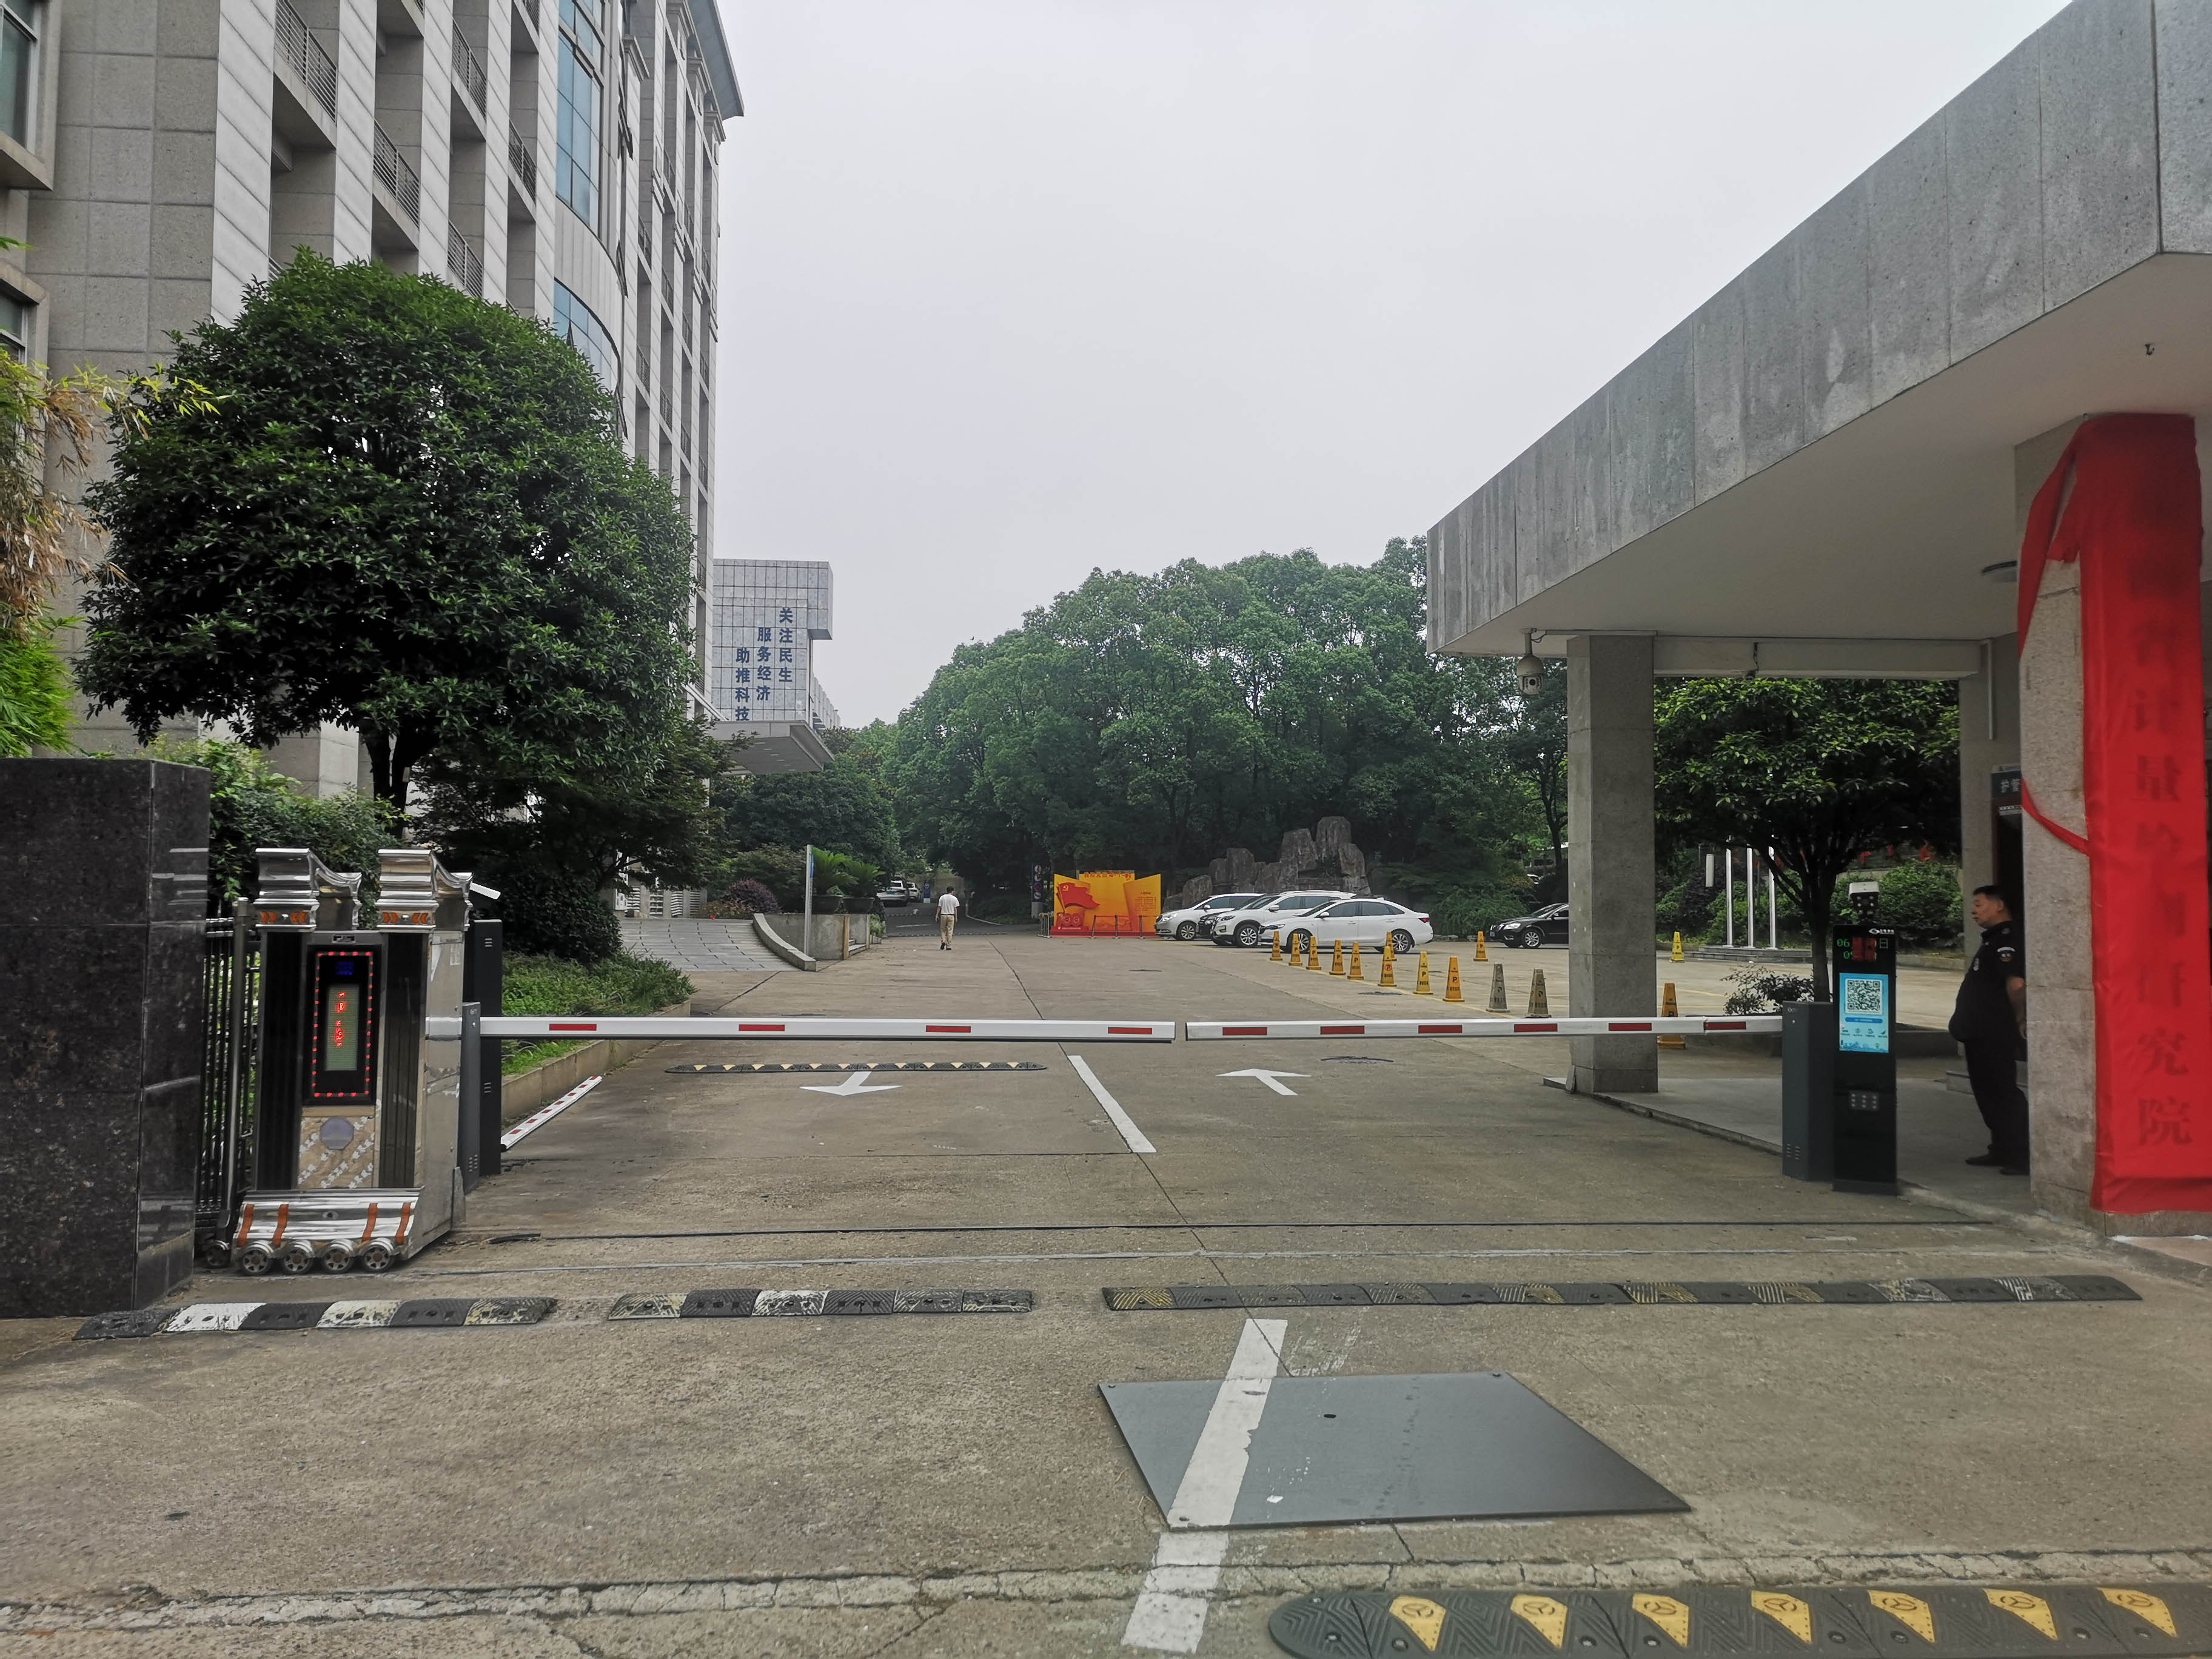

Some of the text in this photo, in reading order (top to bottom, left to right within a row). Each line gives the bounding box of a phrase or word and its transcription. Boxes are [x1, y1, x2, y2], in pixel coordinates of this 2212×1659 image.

[756, 627, 772, 701] 服务经济
[779, 607, 793, 682] 关注民生
[735, 648, 751, 721] 助推科技
